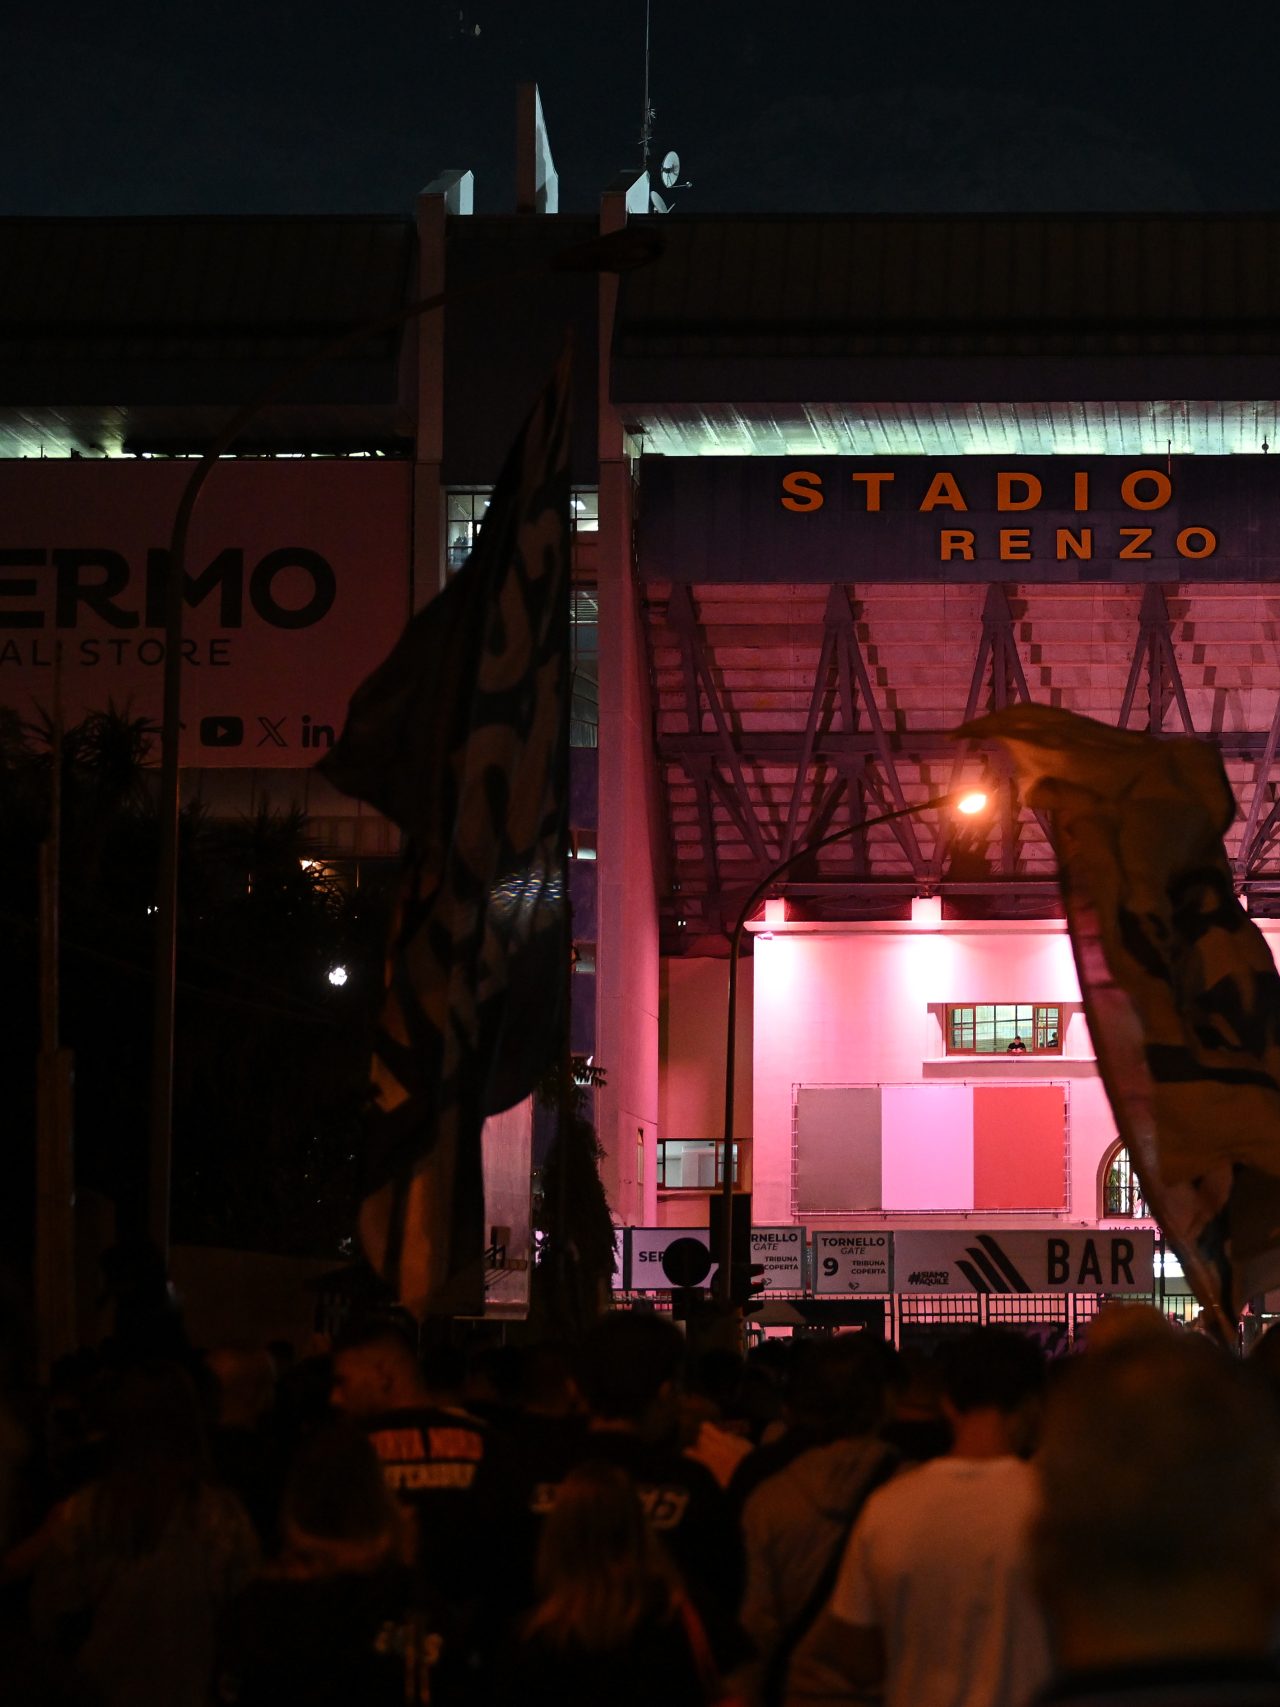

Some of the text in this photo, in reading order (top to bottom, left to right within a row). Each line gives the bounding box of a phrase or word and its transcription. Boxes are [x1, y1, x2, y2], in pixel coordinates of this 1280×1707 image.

[781, 469, 1173, 512] STADIO
[940, 527, 1217, 561] RENZO
[80, 639, 232, 667] STORE
[752, 1233, 798, 1243] RNELLO
[753, 1243, 779, 1251] GATE
[821, 1237, 885, 1247] TORNELLO
[840, 1246, 866, 1255] GATE
[822, 1256, 839, 1276] 9
[1047, 1238, 1136, 1286] BAR
